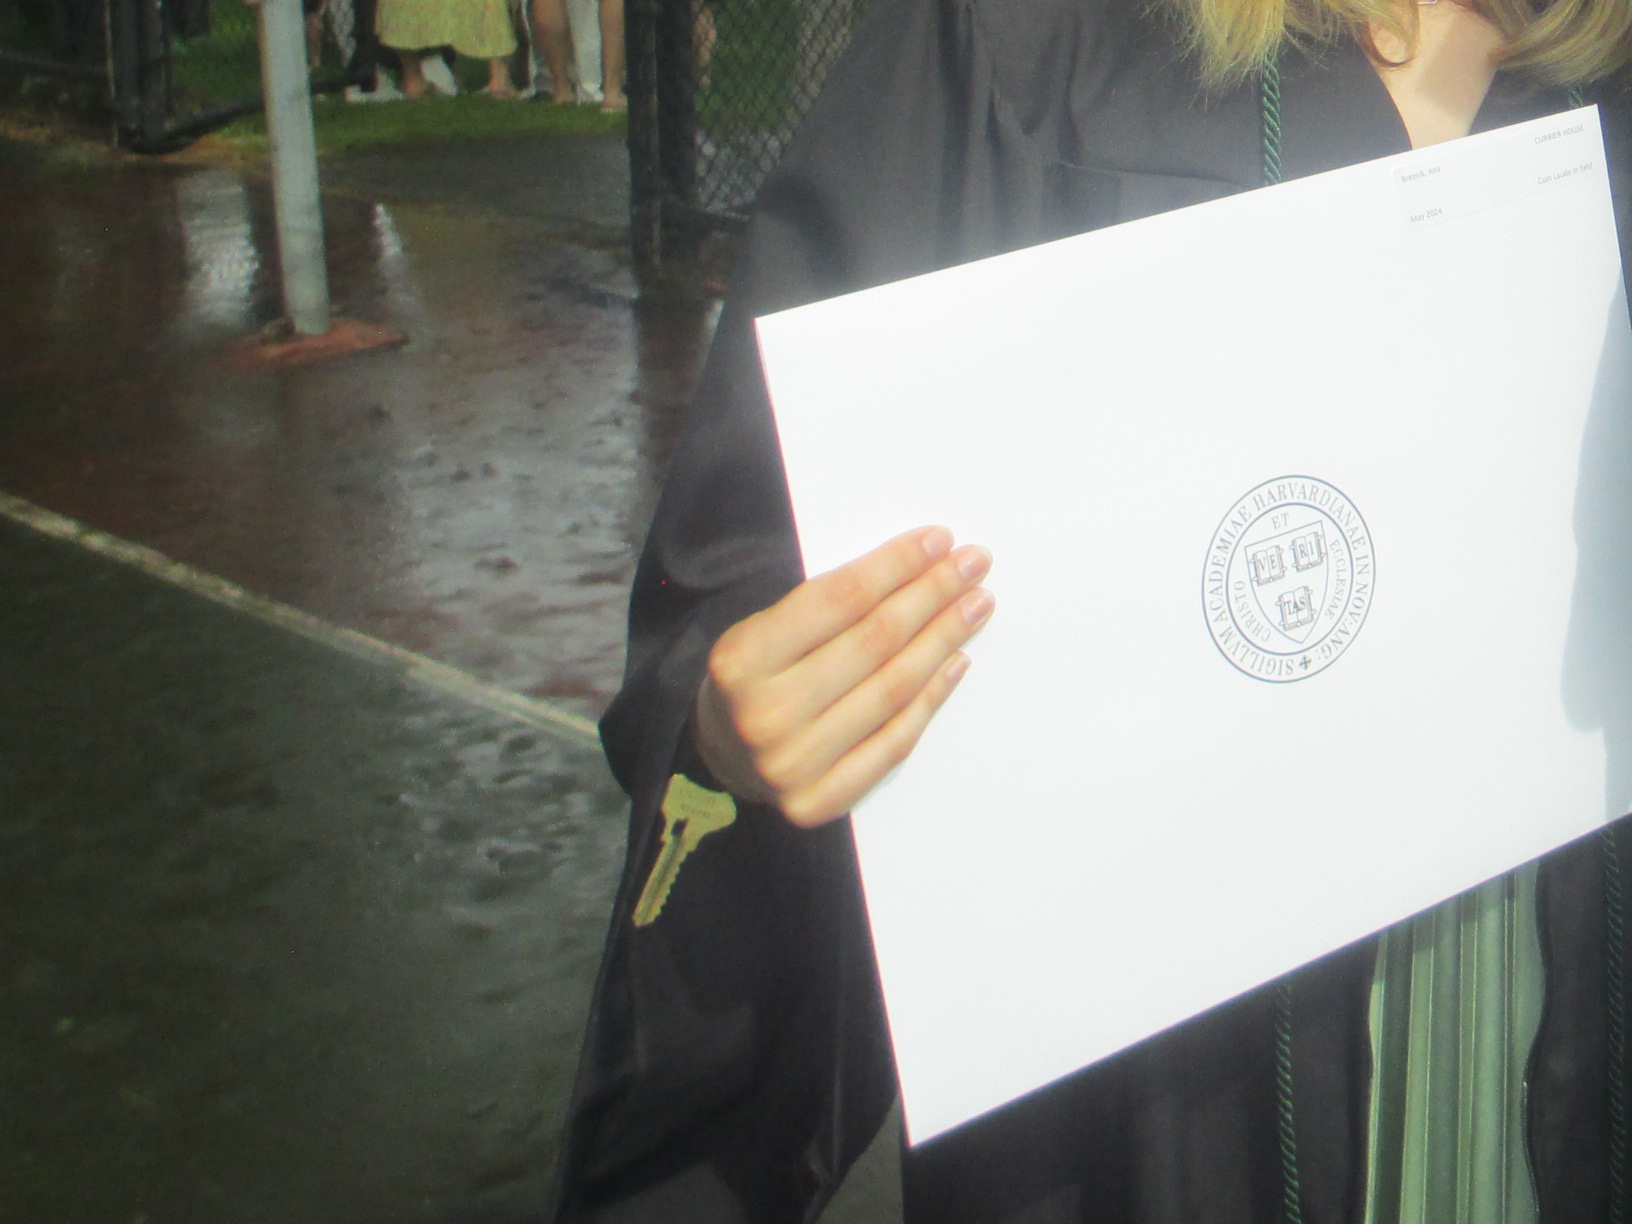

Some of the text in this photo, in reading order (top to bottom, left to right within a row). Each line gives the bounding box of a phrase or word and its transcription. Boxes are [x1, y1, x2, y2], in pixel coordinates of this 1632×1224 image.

[1563, 124, 1584, 137] HOUSE
[1537, 175, 1552, 185] Cum
[1553, 169, 1572, 181] Laude
[1410, 212, 1425, 223] May
[1252, 482, 1366, 550] HARVARDIANAE
[1298, 539, 1316, 559] RI
[1208, 505, 1252, 623] ACADEMIAE
[1257, 553, 1278, 572] VE
[1355, 554, 1370, 575] IN
[1233, 512, 1347, 643] CHRISTO ET ECCLESIAE
[1283, 595, 1306, 615] TAS
[1219, 625, 1294, 676] SIGILLVM
